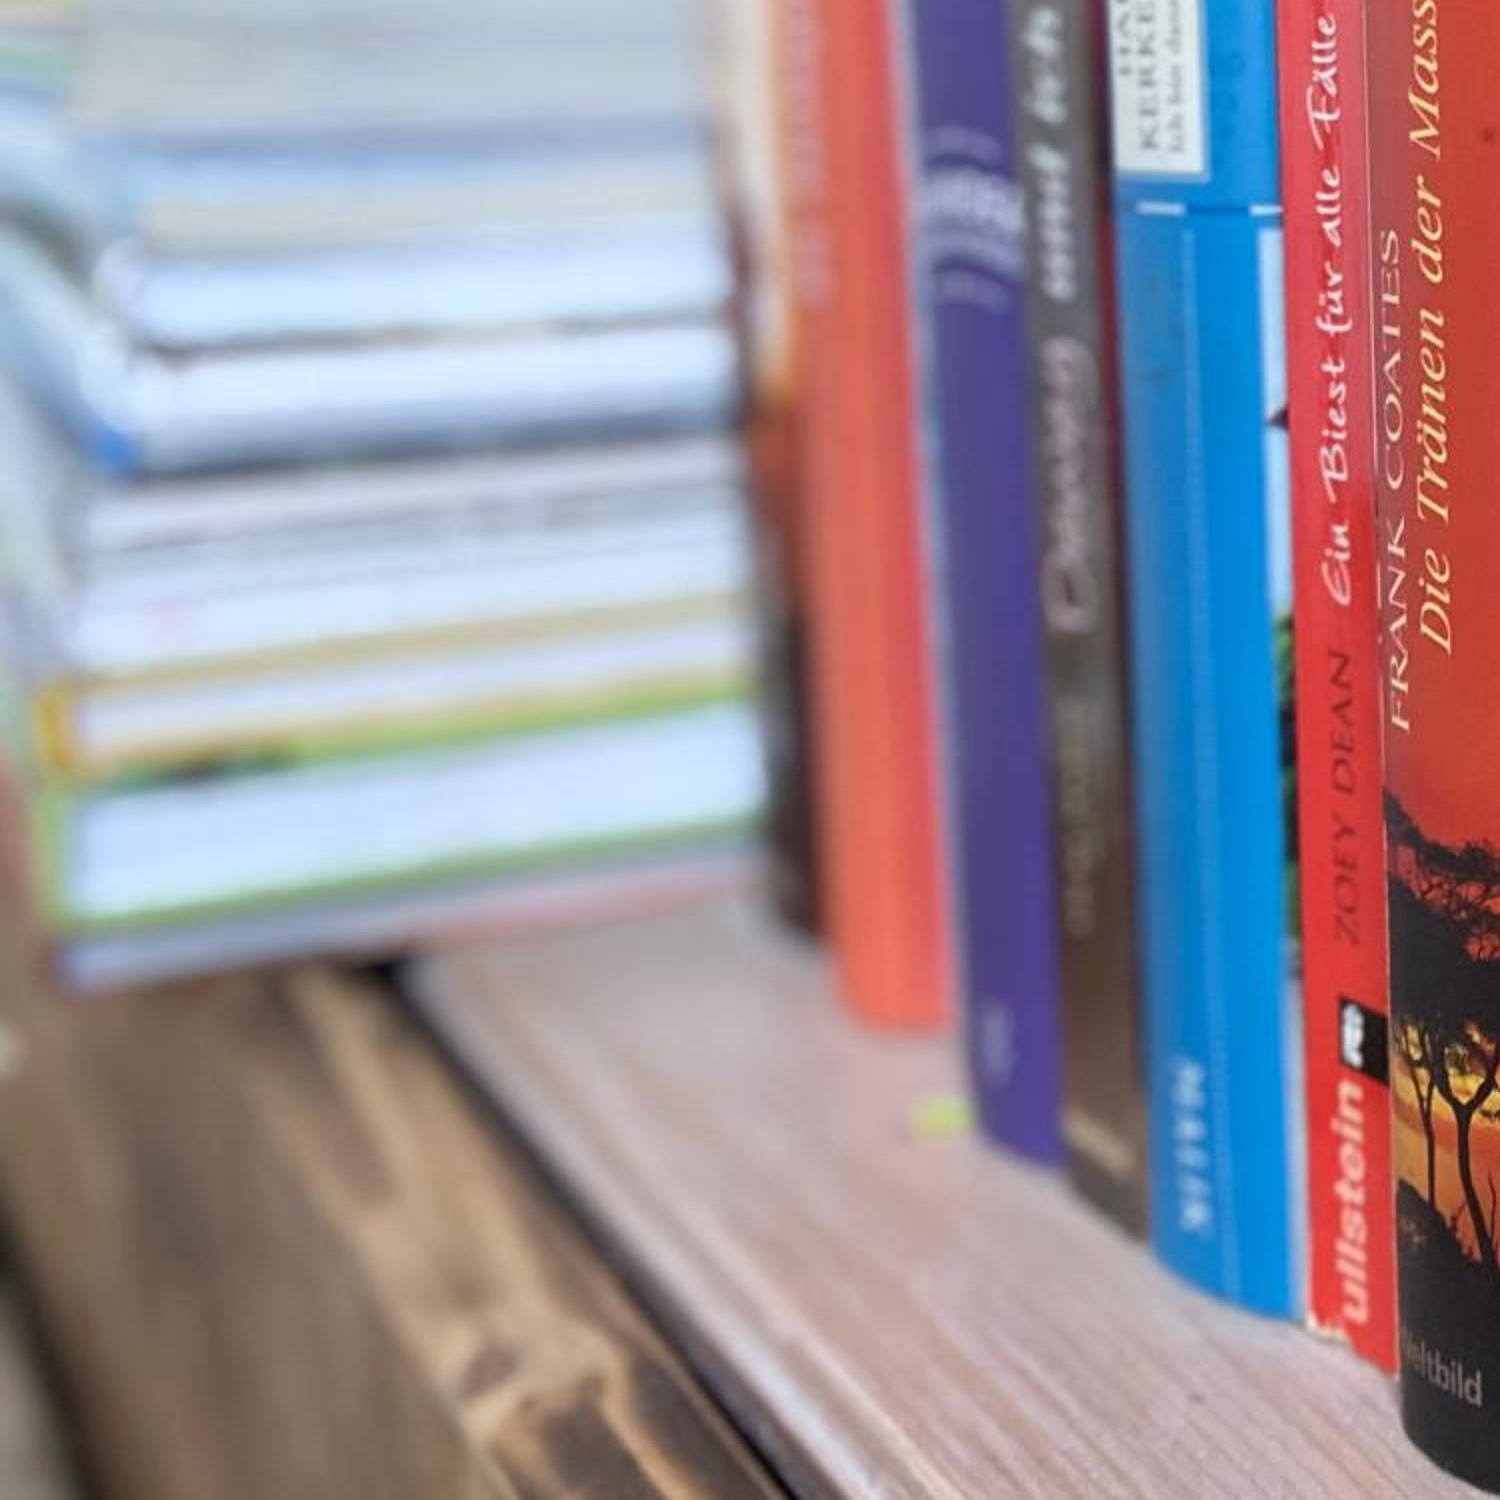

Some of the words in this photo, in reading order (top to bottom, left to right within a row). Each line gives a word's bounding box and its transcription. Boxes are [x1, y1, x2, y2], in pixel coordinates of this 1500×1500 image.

[1305, 11, 1341, 152] Fälle
[1314, 164, 1343, 249] alle
[1410, 175, 1445, 285] der
[1315, 263, 1353, 338] für
[1380, 227, 1403, 491] COATES
[1318, 355, 1348, 505] Biest
[1415, 306, 1449, 526] Tränen
[1320, 522, 1352, 607] Ein
[1385, 518, 1410, 734] FRANK
[1418, 546, 1453, 658] Die
[1327, 650, 1355, 797] DEAN
[1332, 815, 1359, 948] ZOEY
[1330, 1078, 1370, 1326] ullstein
